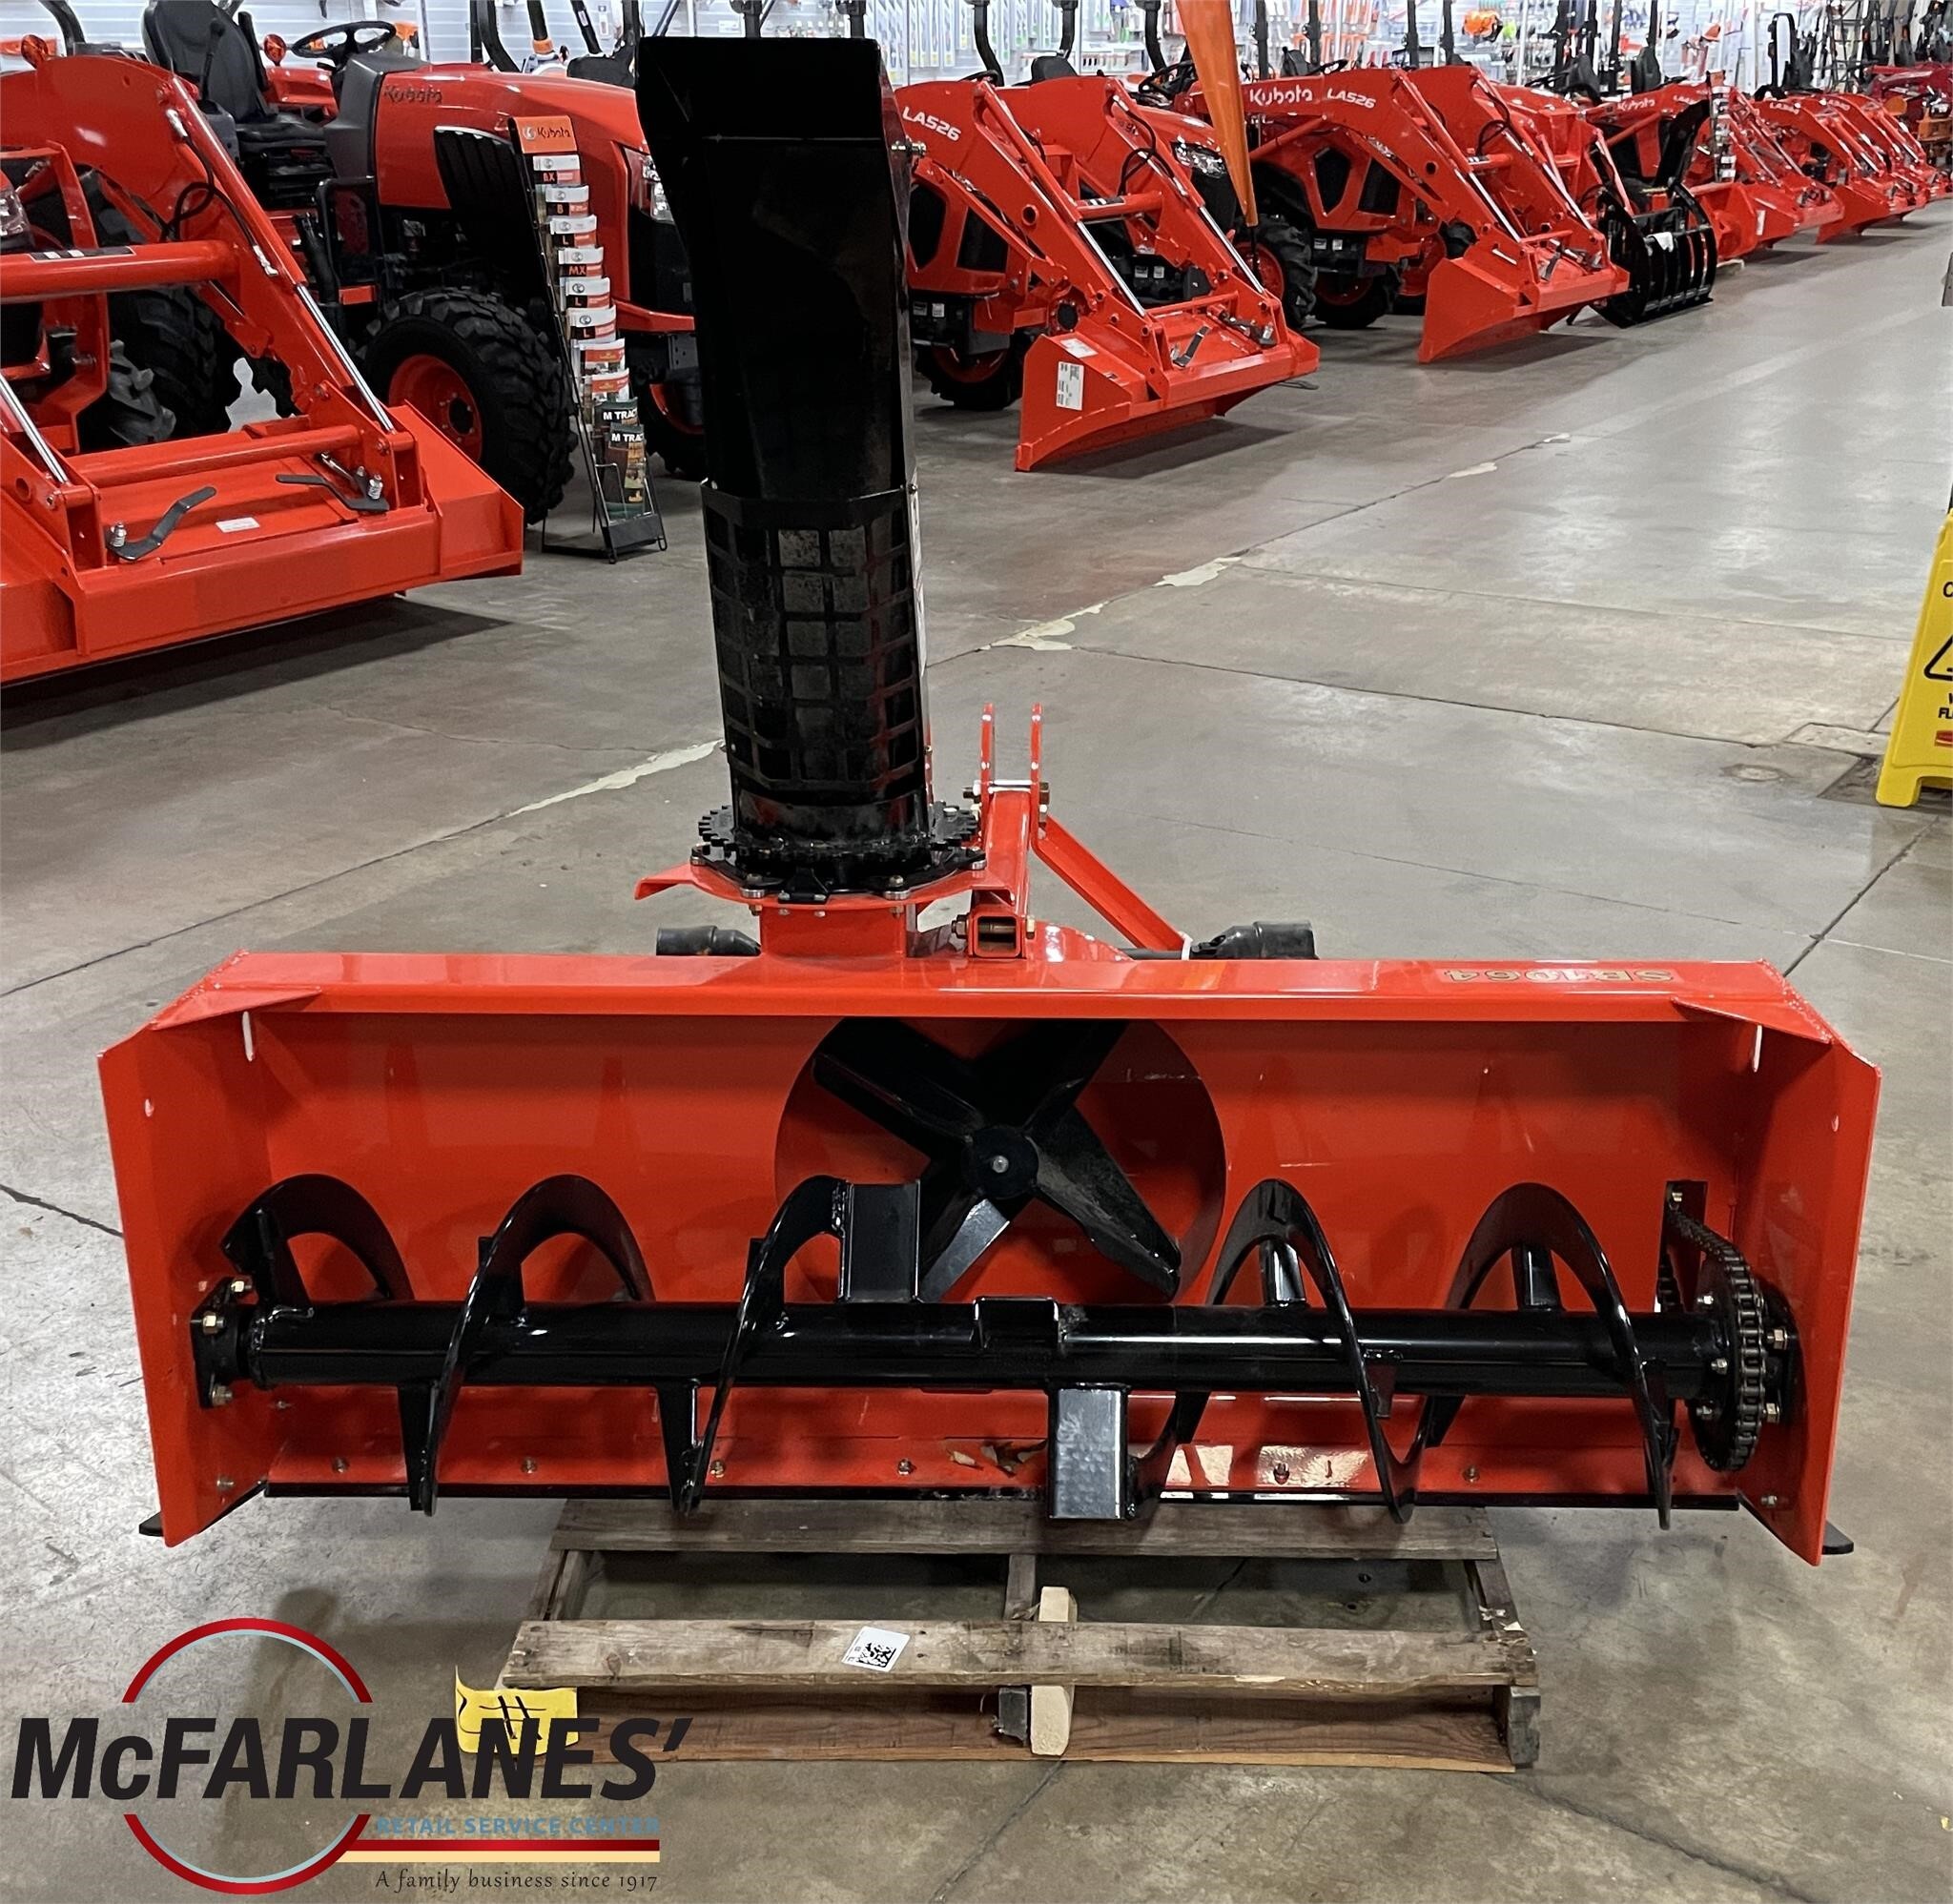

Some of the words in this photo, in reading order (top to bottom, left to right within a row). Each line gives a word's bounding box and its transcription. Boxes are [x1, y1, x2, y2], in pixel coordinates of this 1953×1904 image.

[383, 85, 442, 104] Kubota
[1249, 85, 1312, 107] Kubota
[1327, 88, 1376, 109] LA526
[902, 106, 962, 142] LA526
[537, 126, 570, 139] Kubota
[568, 266, 586, 276] MX
[603, 411, 612, 420] M
[611, 433, 621, 442] M
